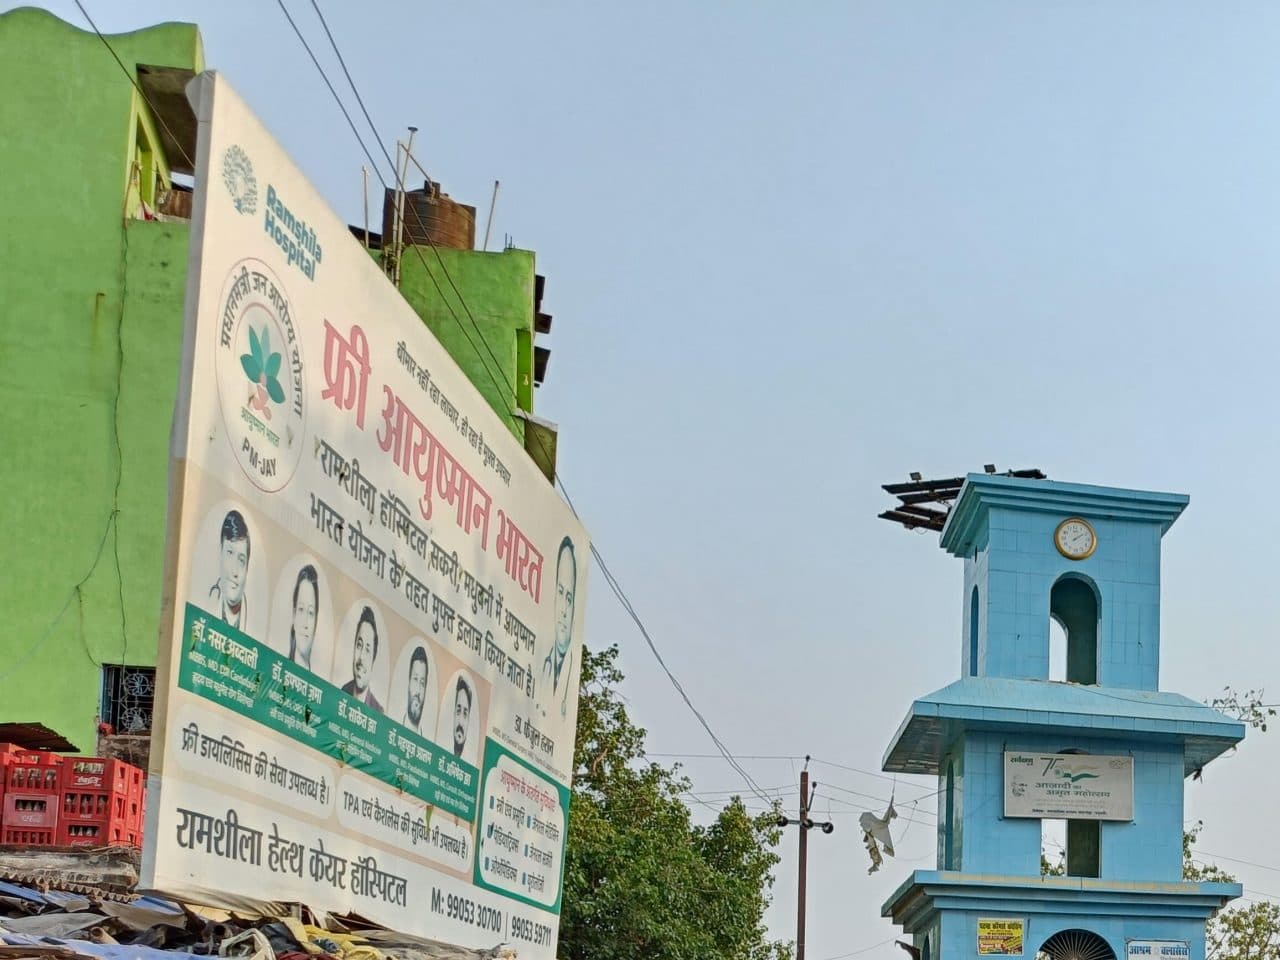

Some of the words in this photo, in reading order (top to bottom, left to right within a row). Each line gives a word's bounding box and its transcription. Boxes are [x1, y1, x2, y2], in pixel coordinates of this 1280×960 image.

[264, 209, 316, 282] Hospital
[265, 183, 322, 265] Ramshila
[251, 271, 269, 296] जन
[242, 437, 277, 478] PM-JAY
[321, 318, 372, 431] फ्री
[376, 384, 493, 552] आयुष्मान
[495, 508, 544, 604] भारत
[320, 440, 377, 515] रामशीला
[380, 489, 429, 560] हॉस्पिटल
[463, 570, 495, 619] मधुबनी
[495, 593, 504, 627] में
[503, 608, 537, 656] आयुष्मान
[310, 493, 345, 546] भारत
[348, 519, 387, 580] योजना
[405, 570, 430, 614] तहत
[456, 614, 483, 657] इलाज
[484, 630, 506, 675] किया
[506, 656, 525, 691] जाता
[200, 735, 252, 775] डायलिसिस
[254, 751, 268, 780] की
[269, 757, 288, 789] सेवा
[288, 770, 319, 801] उपलब्ध
[176, 807, 263, 867] रामशीला
[268, 822, 305, 879] हेल्थ
[309, 838, 348, 891] केयर
[350, 855, 408, 907] हॉस्पिटल
[343, 791, 360, 816] TPA
[361, 796, 374, 819] एवं
[373, 801, 400, 835] कैशलेस
[400, 812, 412, 838] की
[439, 833, 461, 855] उपलब्ध
[431, 887, 445, 914] M:
[447, 893, 475, 925] 99053
[476, 906, 502, 934] 30700
[511, 916, 533, 944] 99053
[533, 922, 553, 948] 59711
